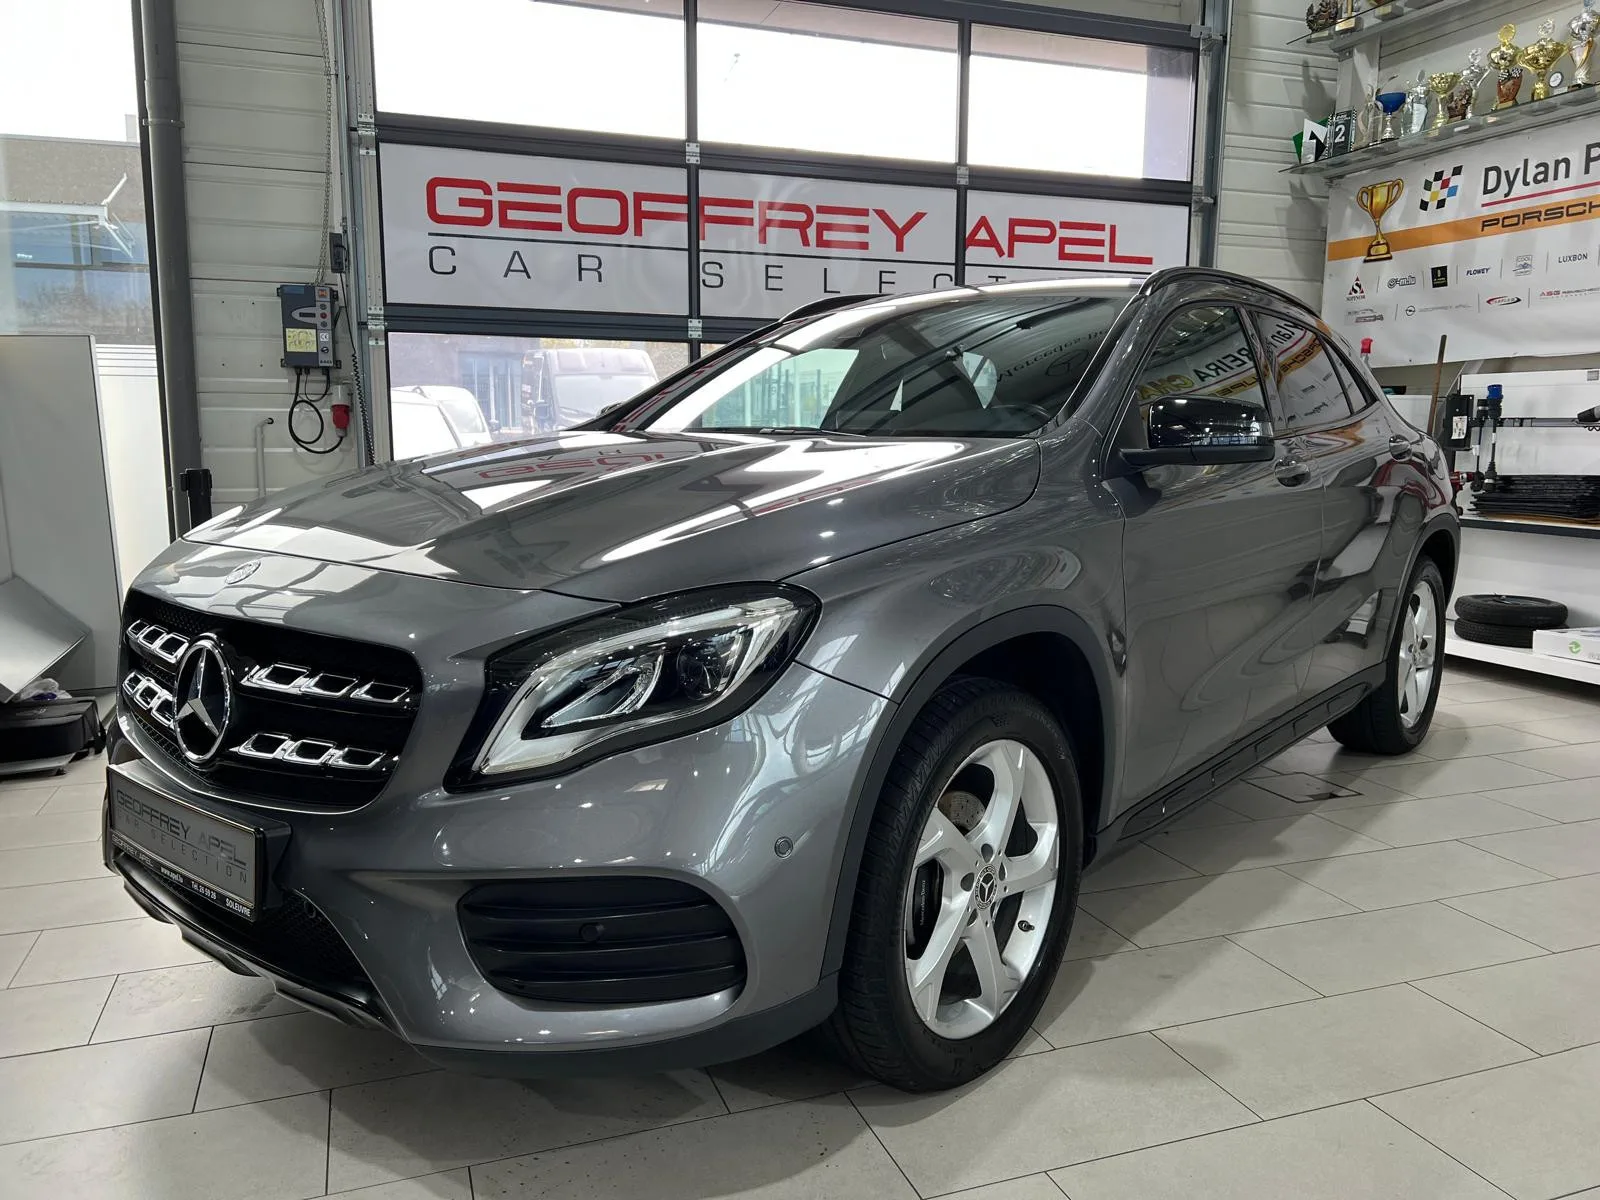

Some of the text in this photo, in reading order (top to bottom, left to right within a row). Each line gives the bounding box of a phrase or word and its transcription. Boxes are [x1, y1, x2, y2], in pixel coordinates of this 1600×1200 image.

[1482, 156, 1570, 198] Dylan
[426, 176, 1153, 265] GEOFFREY APEL
[429, 246, 603, 282] CAR
[1466, 267, 1491, 276] FLOWEY
[1558, 252, 1588, 263] LUXBON
[116, 789, 248, 866] GEOFFREY APEL
[225, 898, 252, 918] SOLEUVRE
